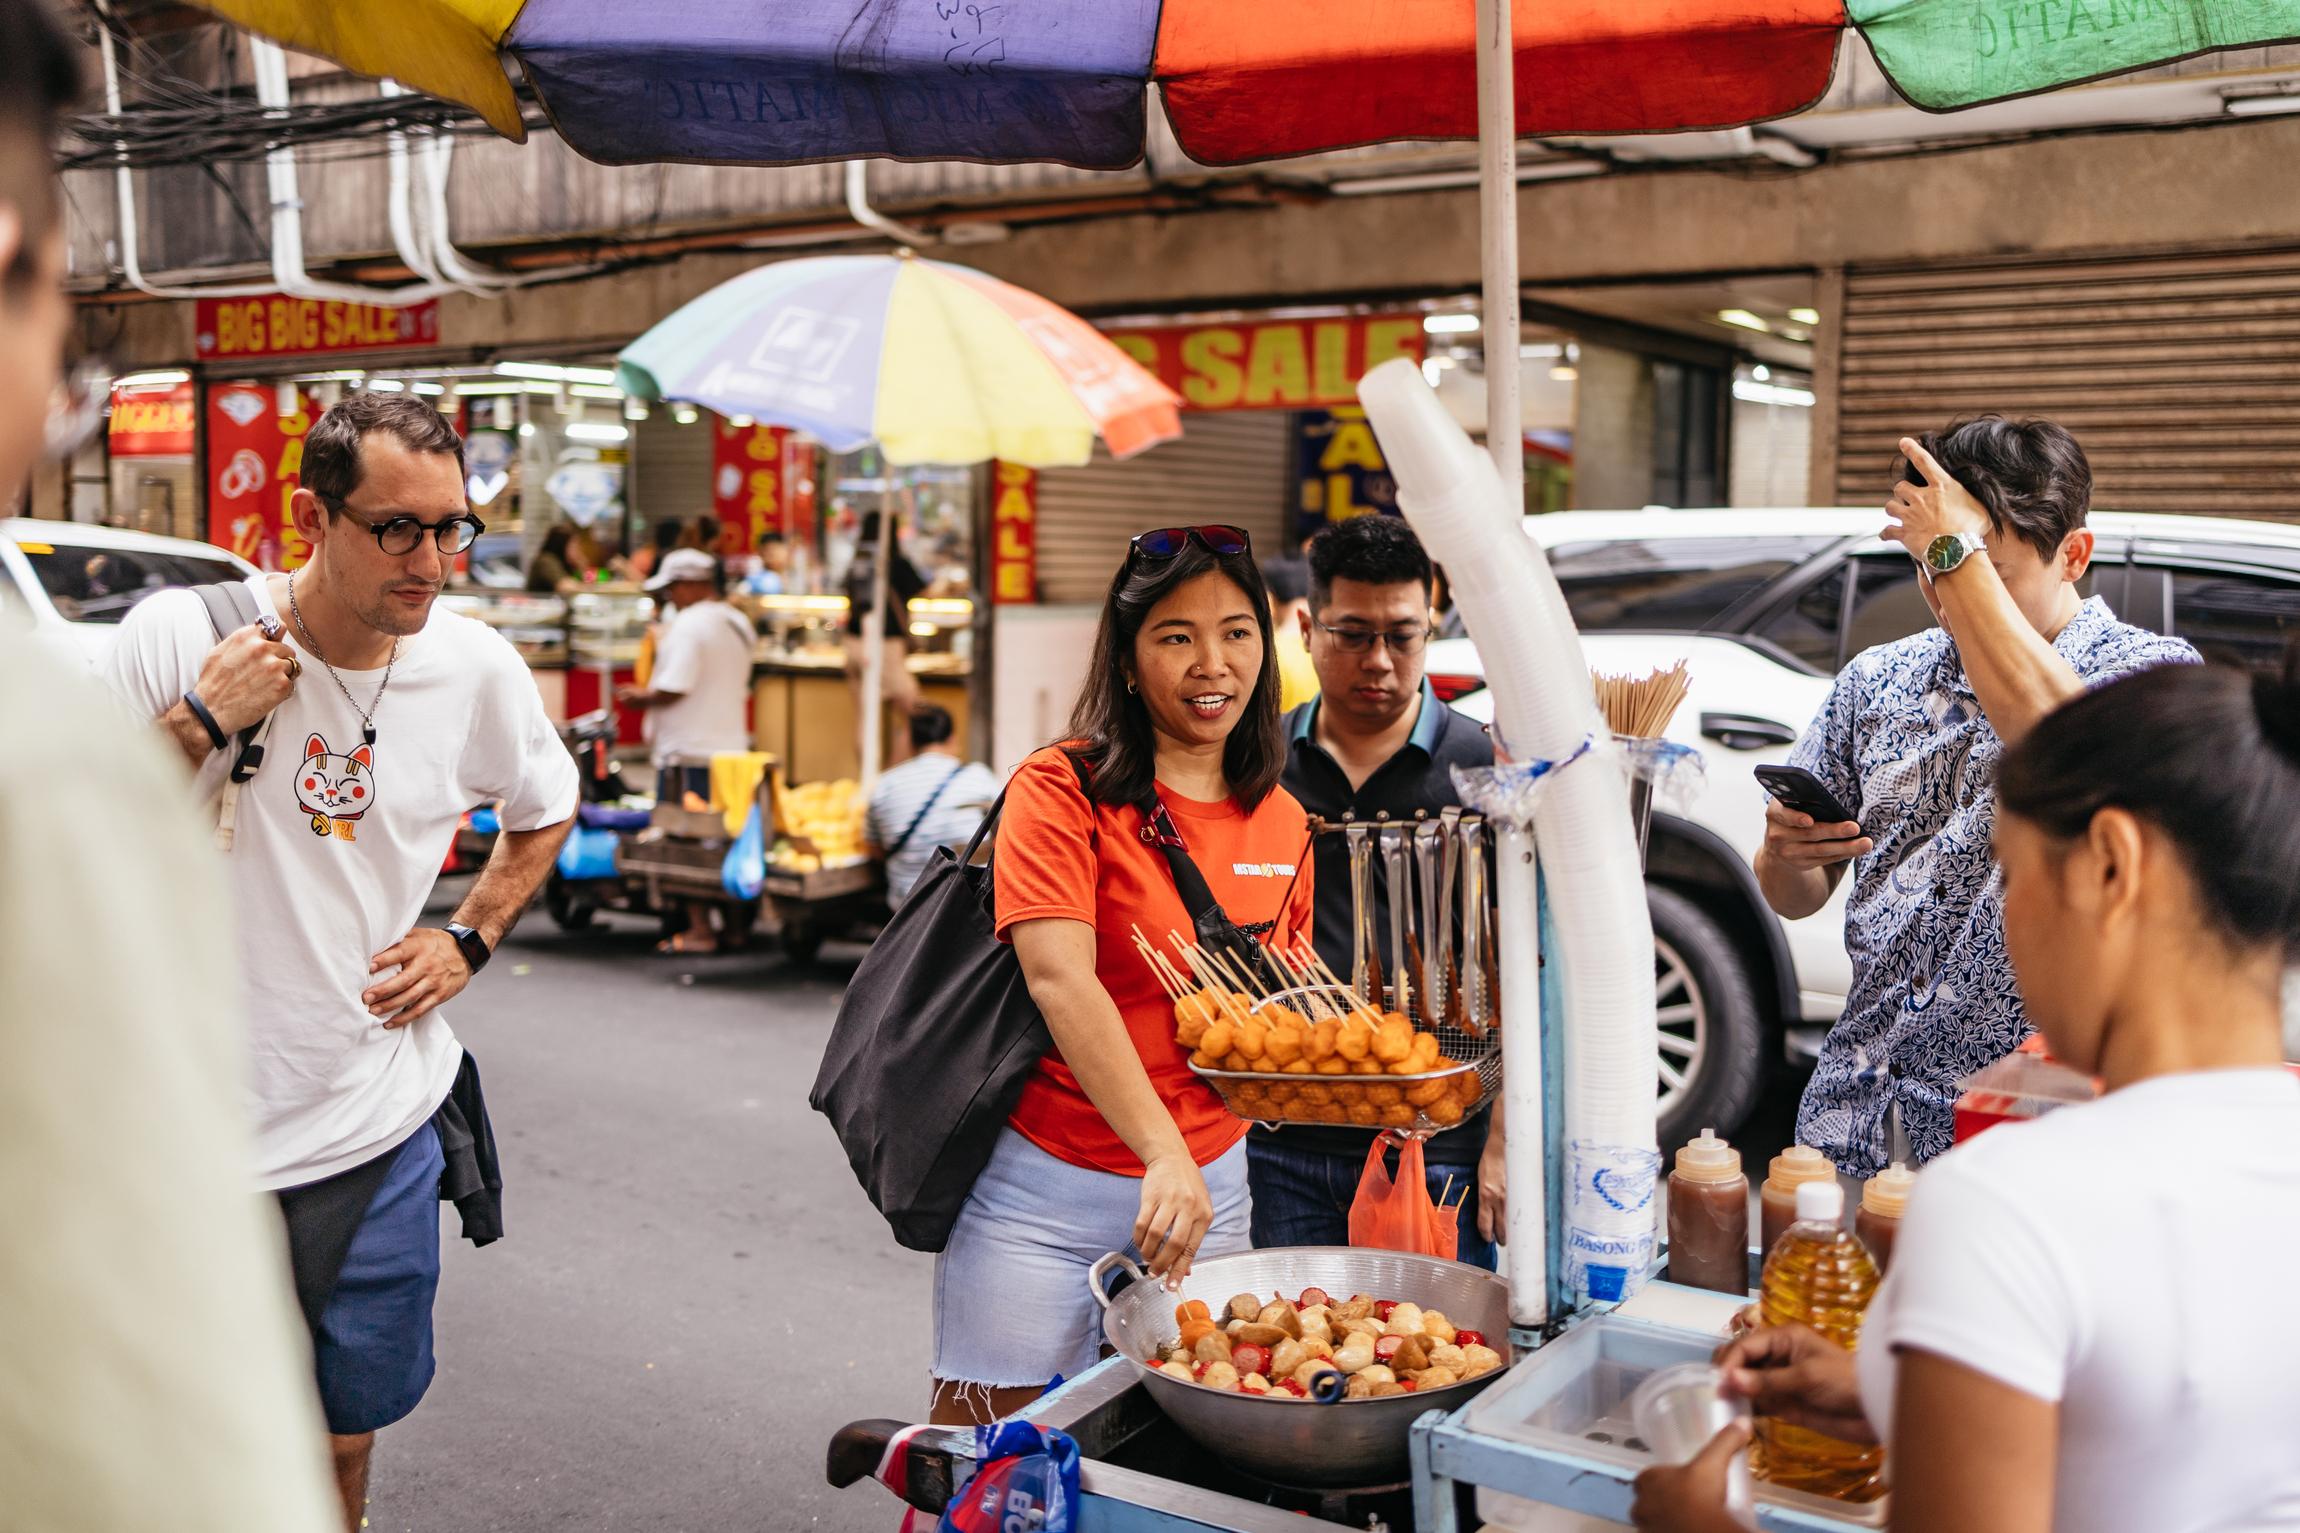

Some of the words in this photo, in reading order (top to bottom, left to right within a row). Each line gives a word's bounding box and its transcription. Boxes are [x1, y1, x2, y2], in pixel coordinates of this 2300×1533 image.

[216, 301, 265, 353] BIG
[269, 299, 319, 350] BIG
[323, 300, 399, 348] SALE
[1573, 1235, 1636, 1256] BASONG
